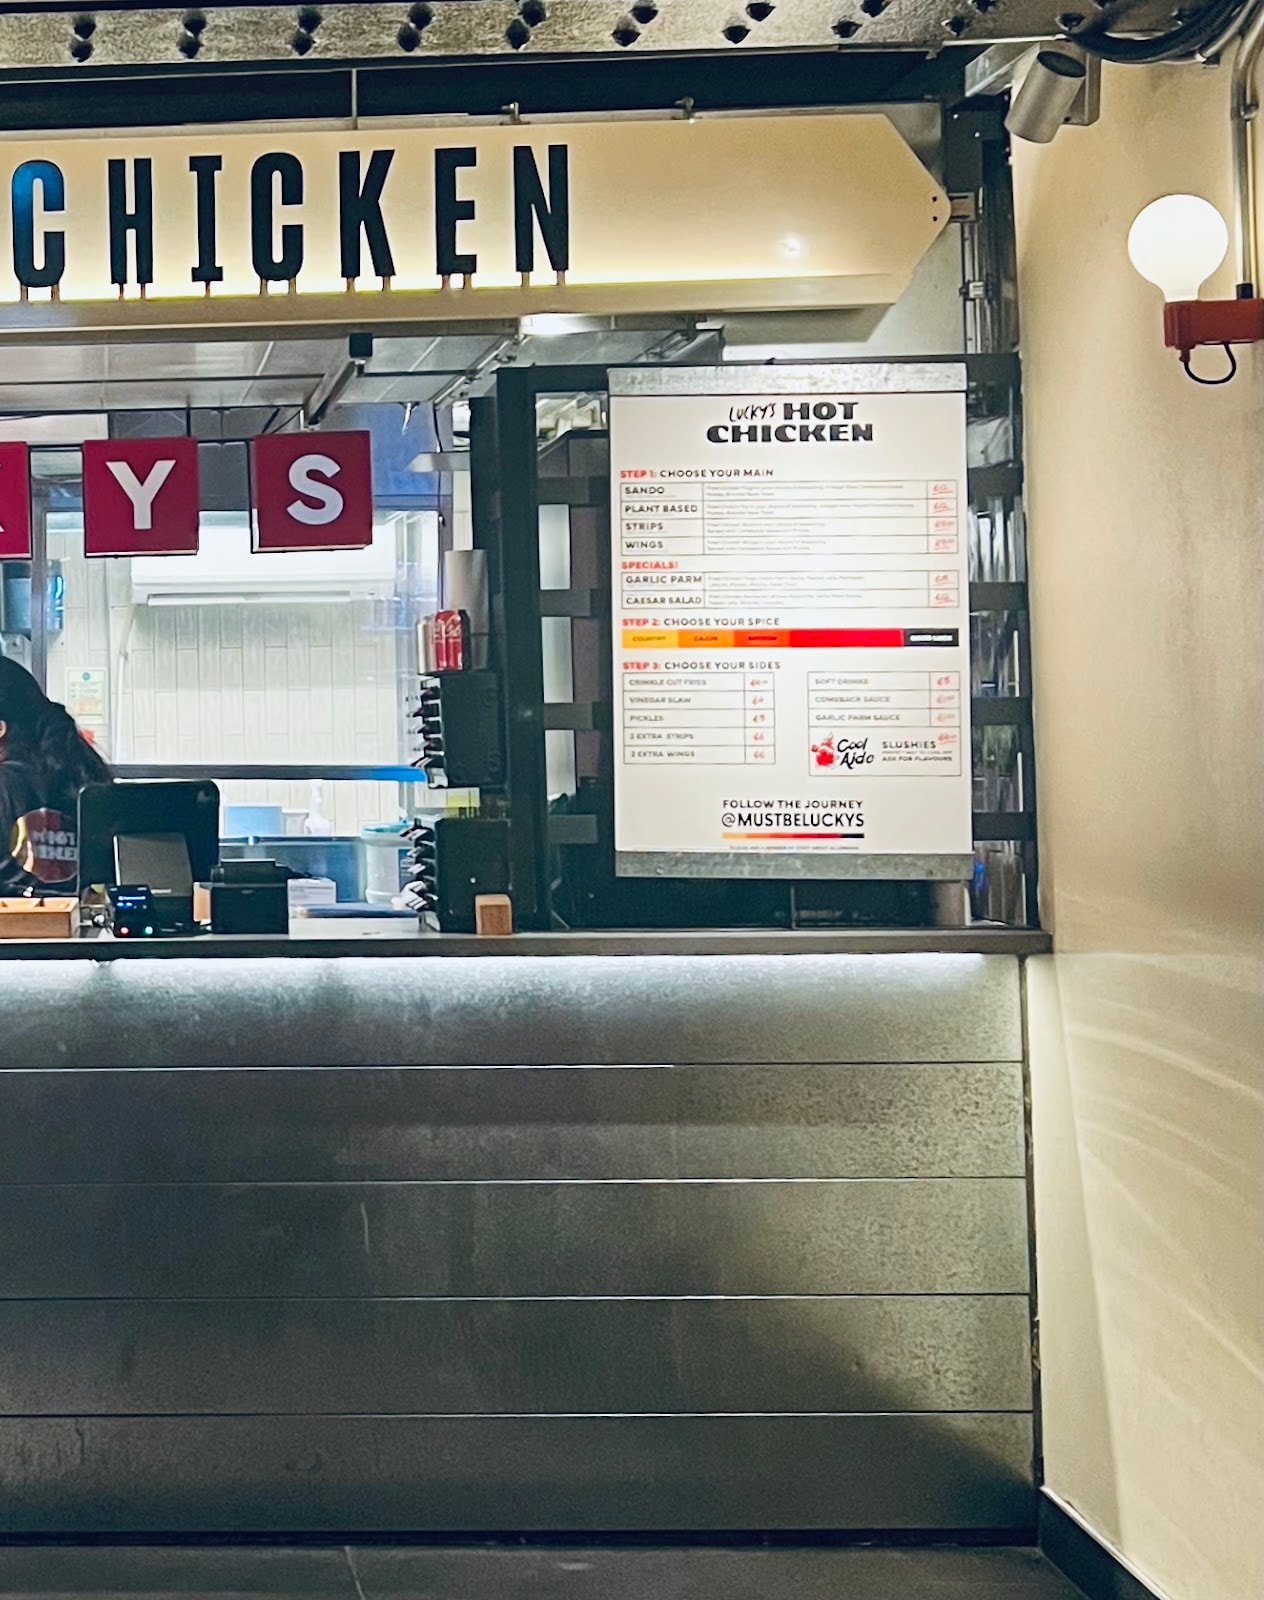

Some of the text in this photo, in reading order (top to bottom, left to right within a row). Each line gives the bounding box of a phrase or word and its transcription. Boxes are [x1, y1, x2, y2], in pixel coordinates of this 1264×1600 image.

[11, 144, 569, 288] CHICKEN
[783, 401, 859, 420] HOT
[706, 424, 873, 443] CHICKEN
[620, 469, 648, 479] STEP
[660, 469, 707, 478] CHOOSE
[709, 469, 740, 477] YOUR
[743, 468, 774, 477] MAIN
[625, 486, 665, 495] SANDO
[625, 505, 660, 513] PLANT
[663, 504, 698, 513] BASED
[625, 522, 664, 531] STRIPS
[625, 541, 664, 549] WINGS
[625, 575, 667, 584] GARLIC
[670, 574, 703, 583] PARM
[626, 596, 666, 605] CAESAR
[669, 596, 702, 604] SALAD
[622, 618, 649, 626] STEP
[664, 617, 711, 626] CHOOSE
[715, 617, 745, 626] YOUR
[748, 617, 780, 626] SPICE
[622, 662, 650, 670] STEP
[664, 661, 712, 670] CHOOSE
[715, 661, 745, 670] YOUR
[748, 661, 781, 669] SIDES
[837, 737, 869, 753] Cool
[882, 740, 937, 749] SLUSHIES
[667, 750, 696, 758] WINGS
[722, 799, 864, 809] FOLLOW THE JOURNEY
[721, 812, 865, 828] @MUSTBELUCKYS
